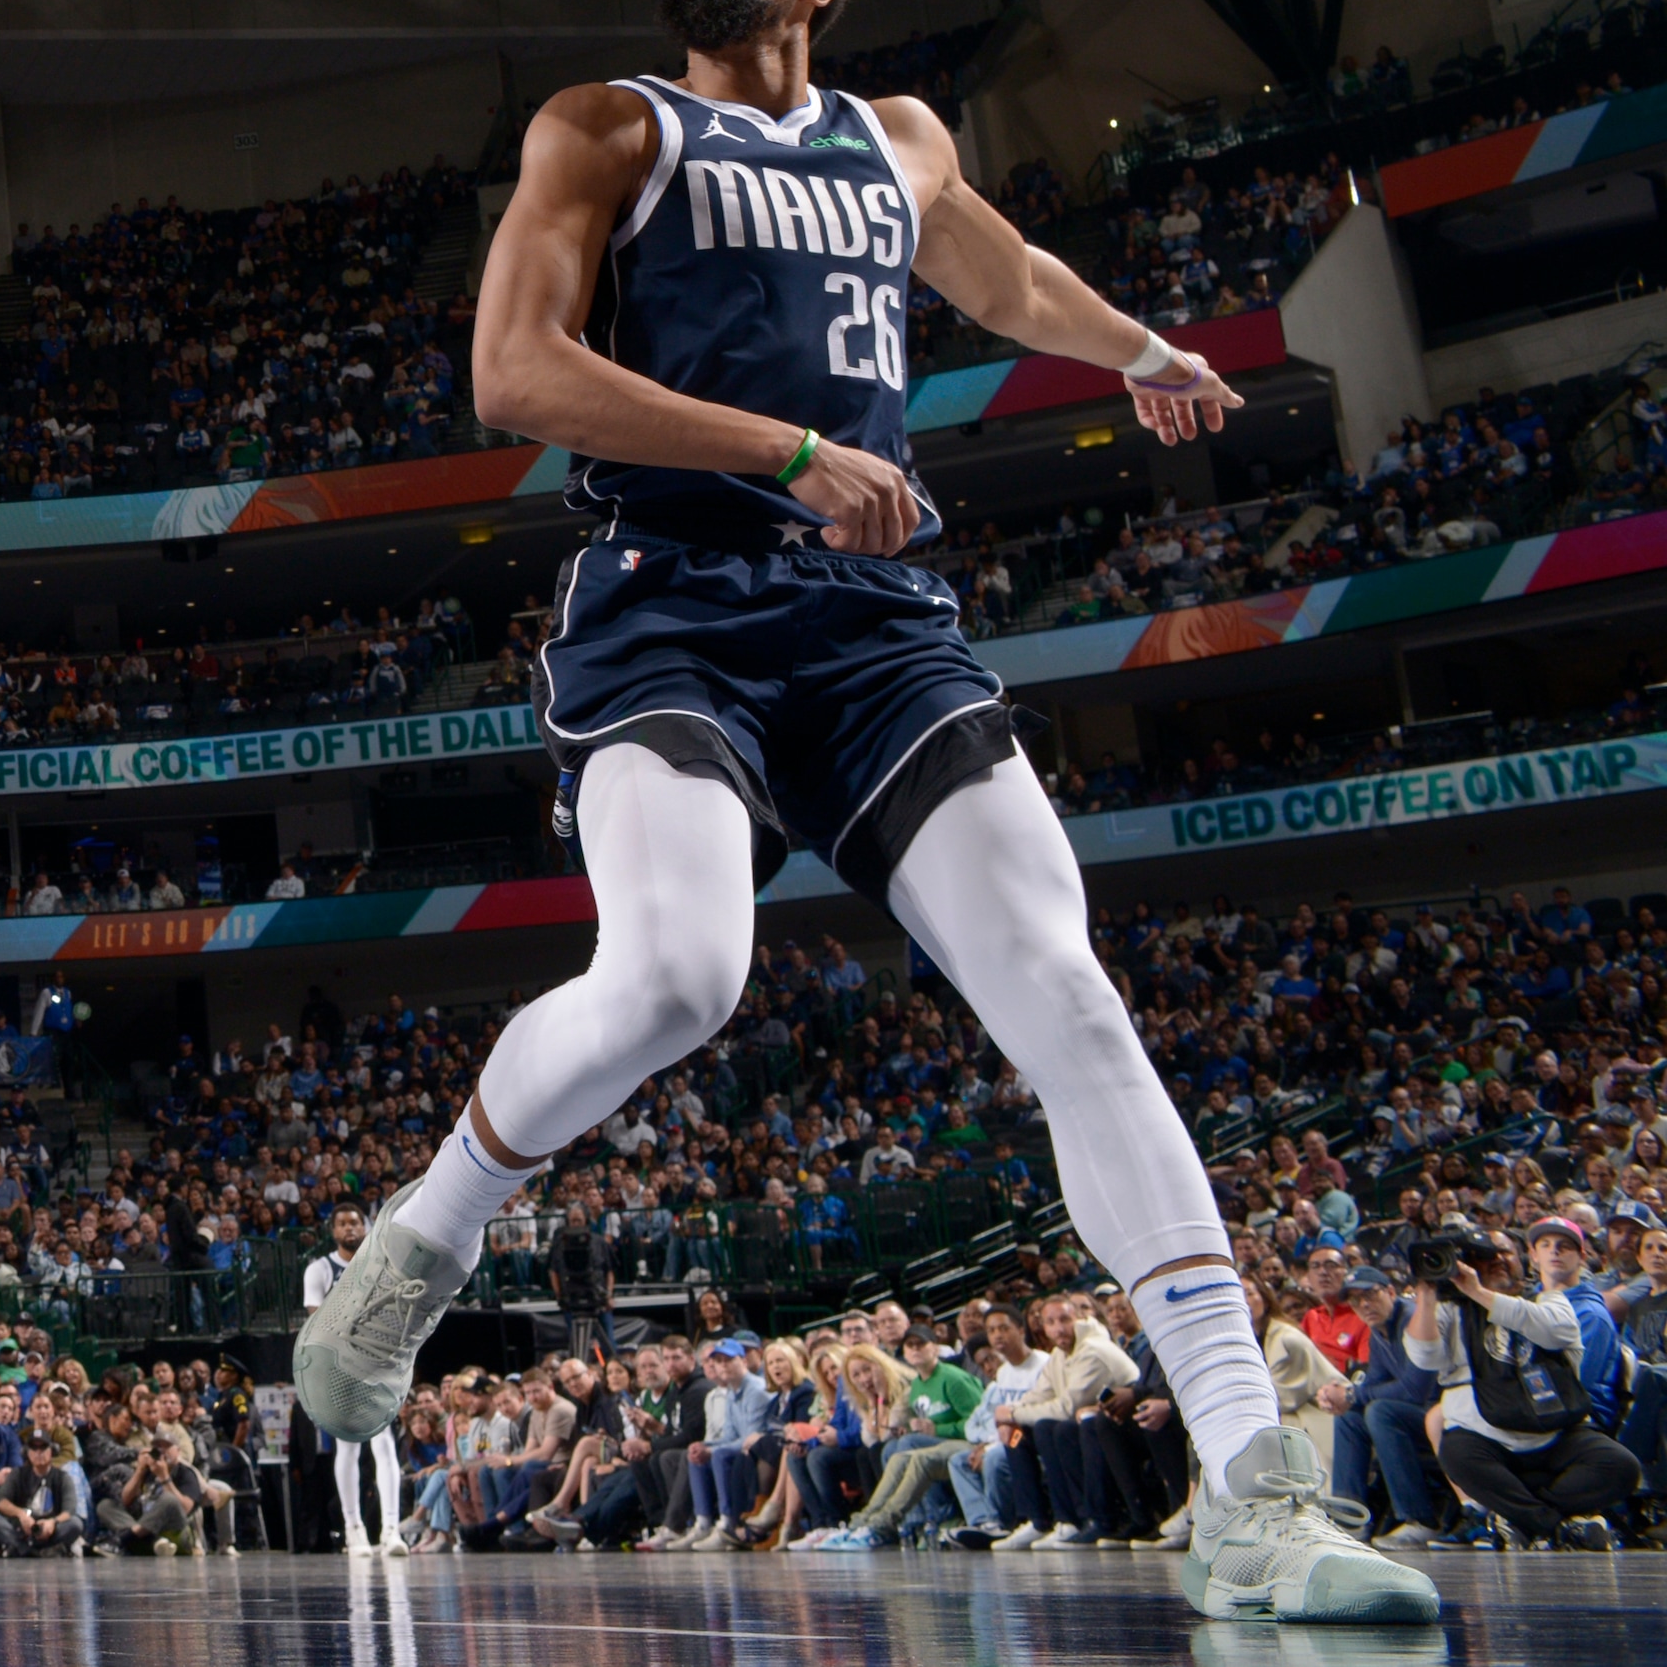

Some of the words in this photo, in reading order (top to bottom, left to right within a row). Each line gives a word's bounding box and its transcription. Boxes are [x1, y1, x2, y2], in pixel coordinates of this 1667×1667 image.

[809, 133, 871, 151] chime
[684, 160, 902, 268] MAVS
[824, 272, 903, 391] 26
[132, 735, 284, 782] COFFEE
[292, 727, 345, 768] OF
[349, 719, 432, 759] THE
[1171, 796, 1274, 846] ICED
[1282, 771, 1457, 831] COFFEE
[1465, 757, 1535, 806] ON
[1538, 743, 1637, 794] TAP
